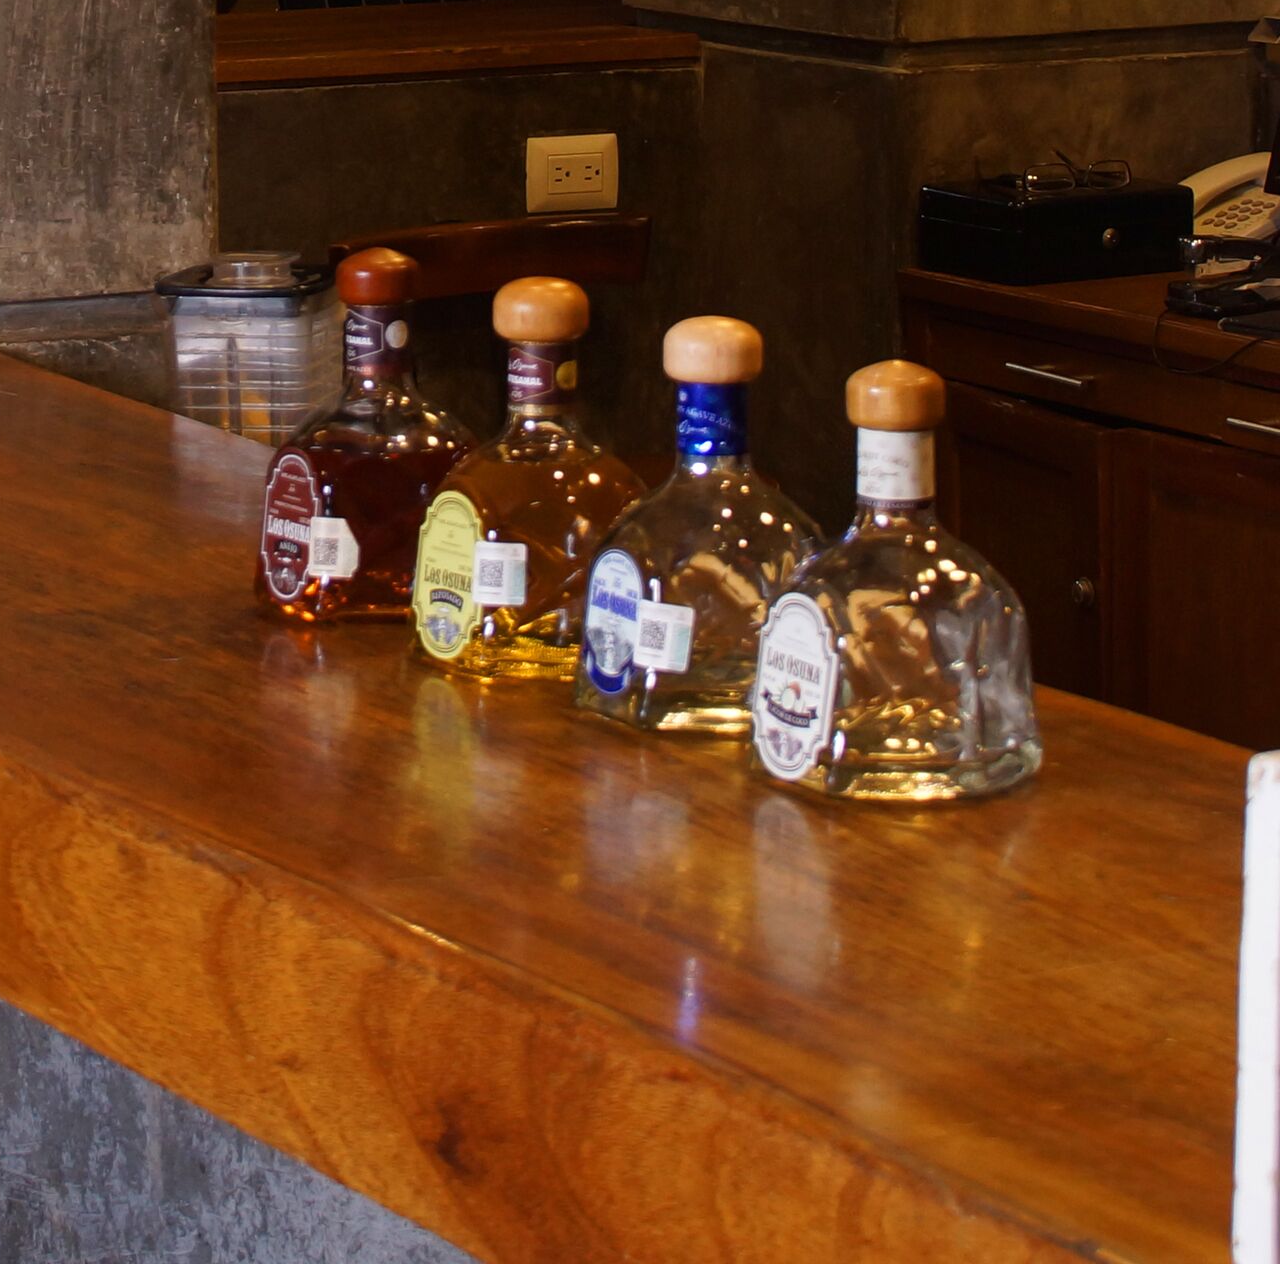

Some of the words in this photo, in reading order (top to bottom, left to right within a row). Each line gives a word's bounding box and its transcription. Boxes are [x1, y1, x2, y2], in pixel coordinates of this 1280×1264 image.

[267, 514, 284, 536] LOS
[283, 519, 311, 543] OSUNA
[424, 564, 441, 585] LOS
[442, 568, 473, 593] OSUNA
[766, 646, 785, 671] LOS
[786, 654, 821, 685] OSUNA
